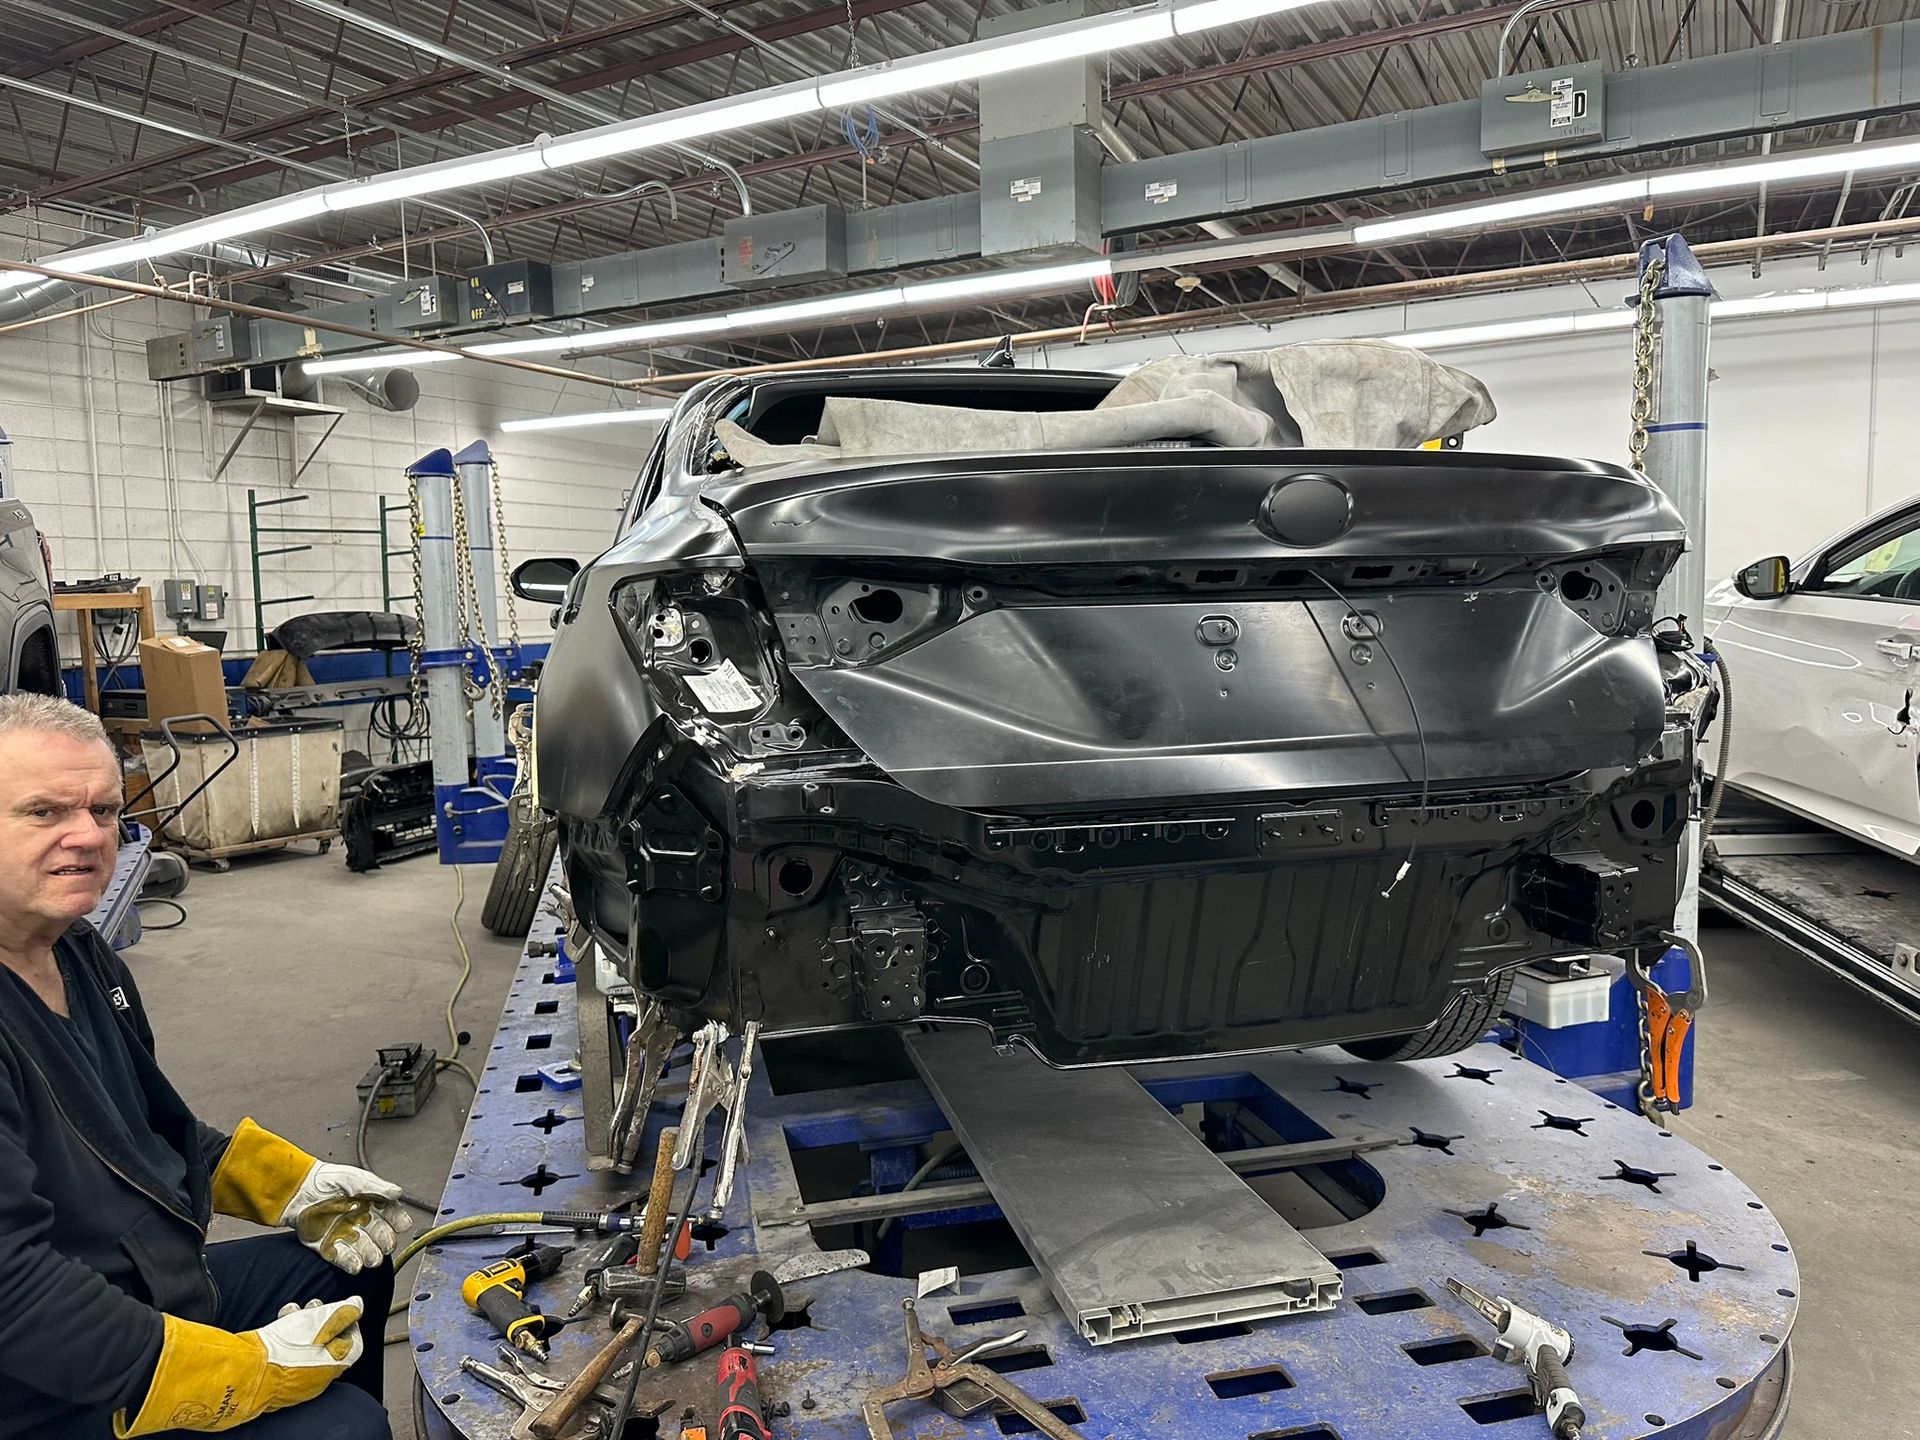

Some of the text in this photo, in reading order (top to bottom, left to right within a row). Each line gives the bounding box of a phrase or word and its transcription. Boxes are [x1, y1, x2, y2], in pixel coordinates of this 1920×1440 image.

[1574, 92, 1586, 117] D
[470, 277, 480, 288] ON
[430, 296, 435, 312] F
[471, 308, 484, 320] OFF
